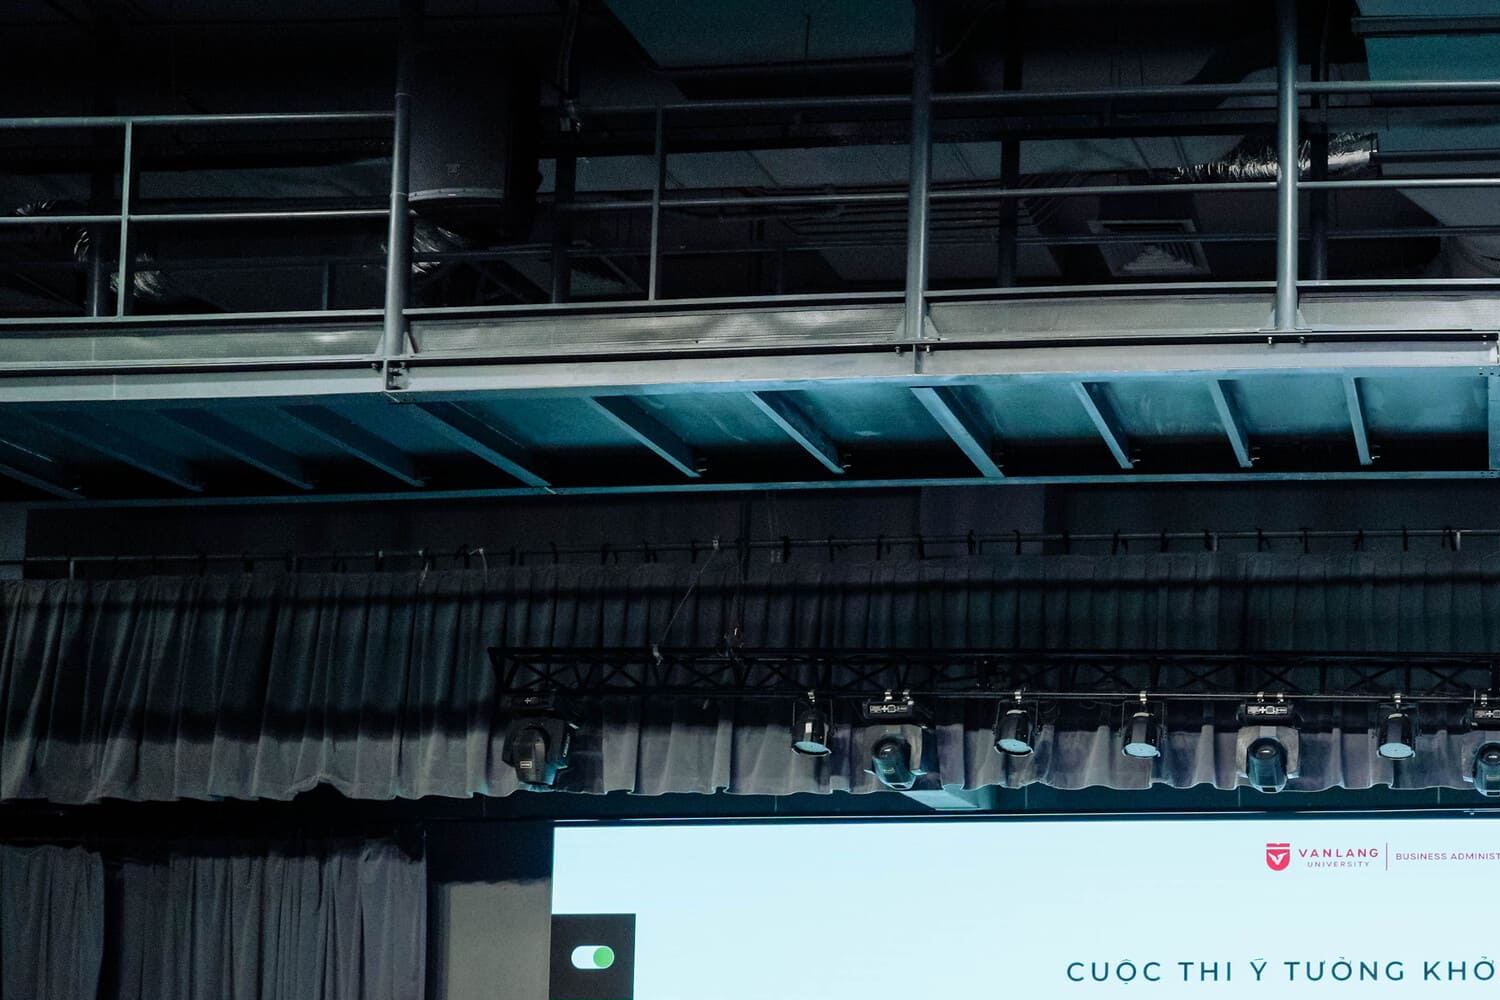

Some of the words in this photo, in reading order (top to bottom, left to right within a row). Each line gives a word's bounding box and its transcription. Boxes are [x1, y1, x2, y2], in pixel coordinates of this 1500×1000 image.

[1299, 847, 1379, 858] VANLANG
[1396, 852, 1447, 861] BUSINESS
[1067, 957, 1162, 985] CUỘC
[1177, 960, 1232, 982] THI
[1249, 956, 1268, 982] Ý
[1283, 955, 1405, 982] TƯỞNG
